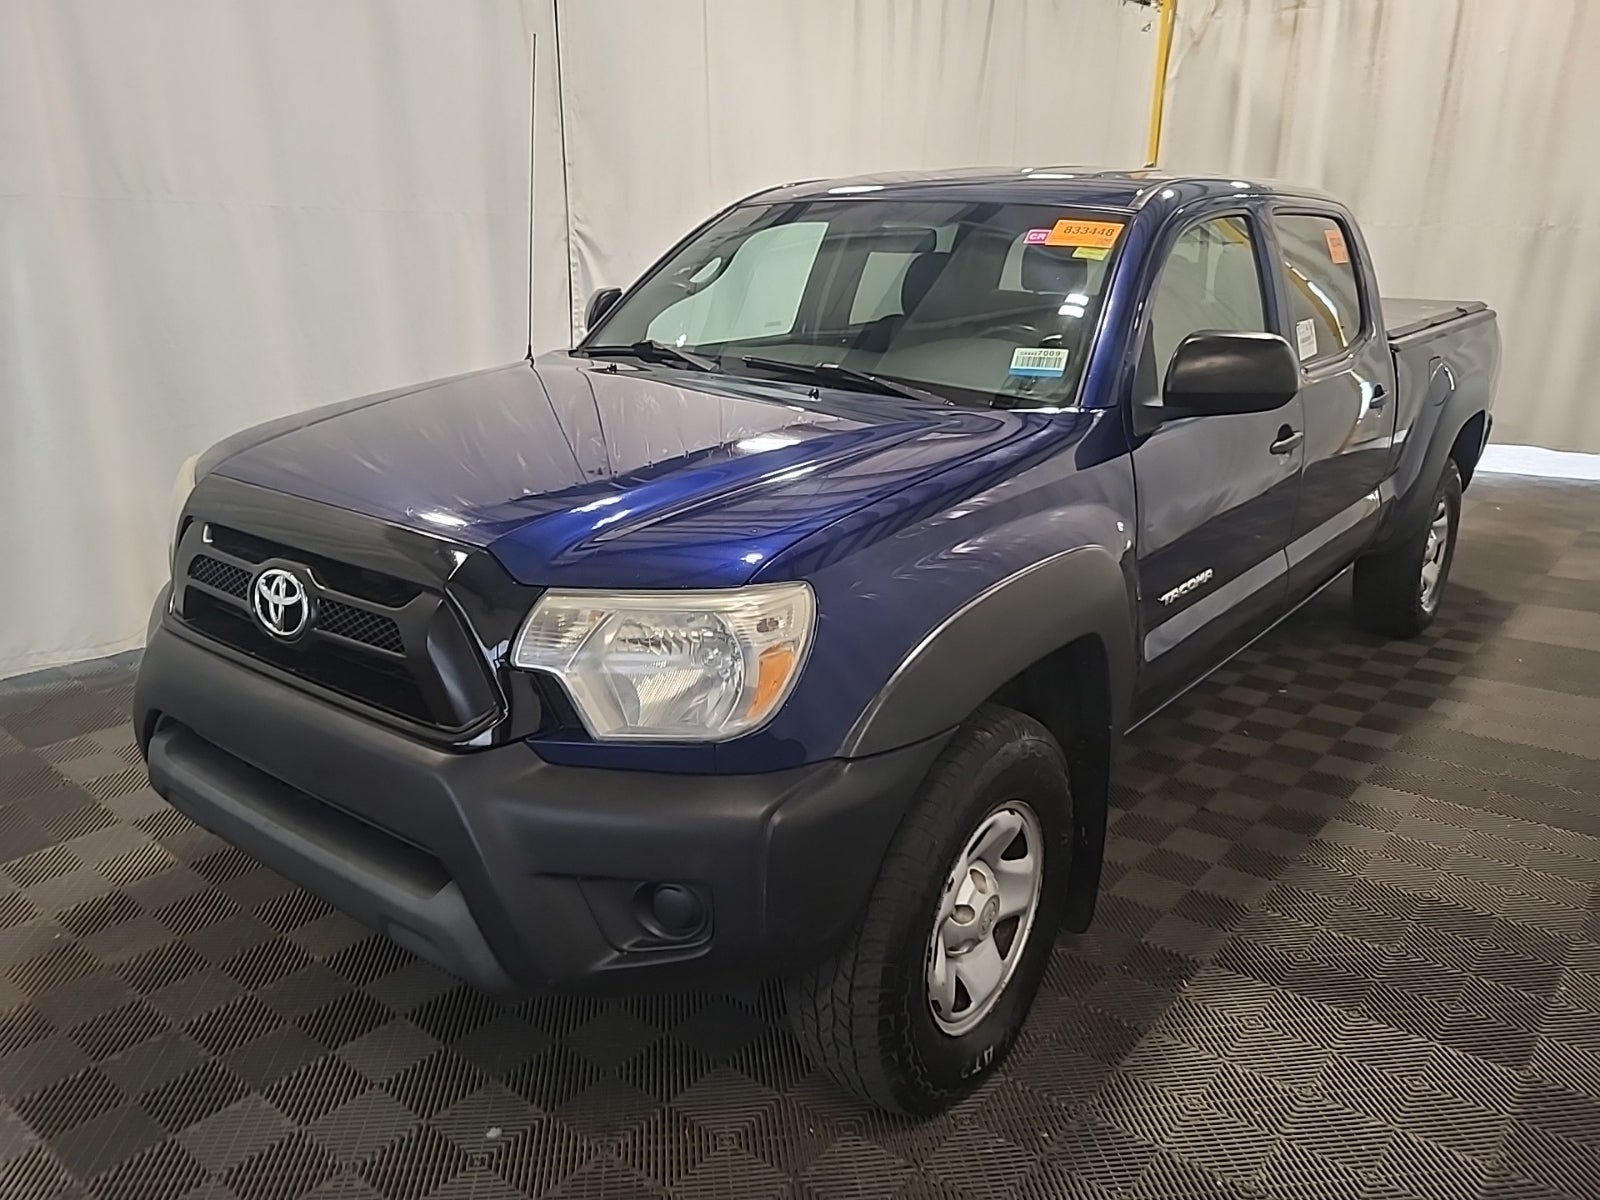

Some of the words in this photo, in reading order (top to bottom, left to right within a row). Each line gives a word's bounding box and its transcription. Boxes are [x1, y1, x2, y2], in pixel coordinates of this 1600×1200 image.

[1029, 231, 1047, 241] CR
[1063, 225, 1115, 237] 833448
[1157, 568, 1213, 606] TACOMA
